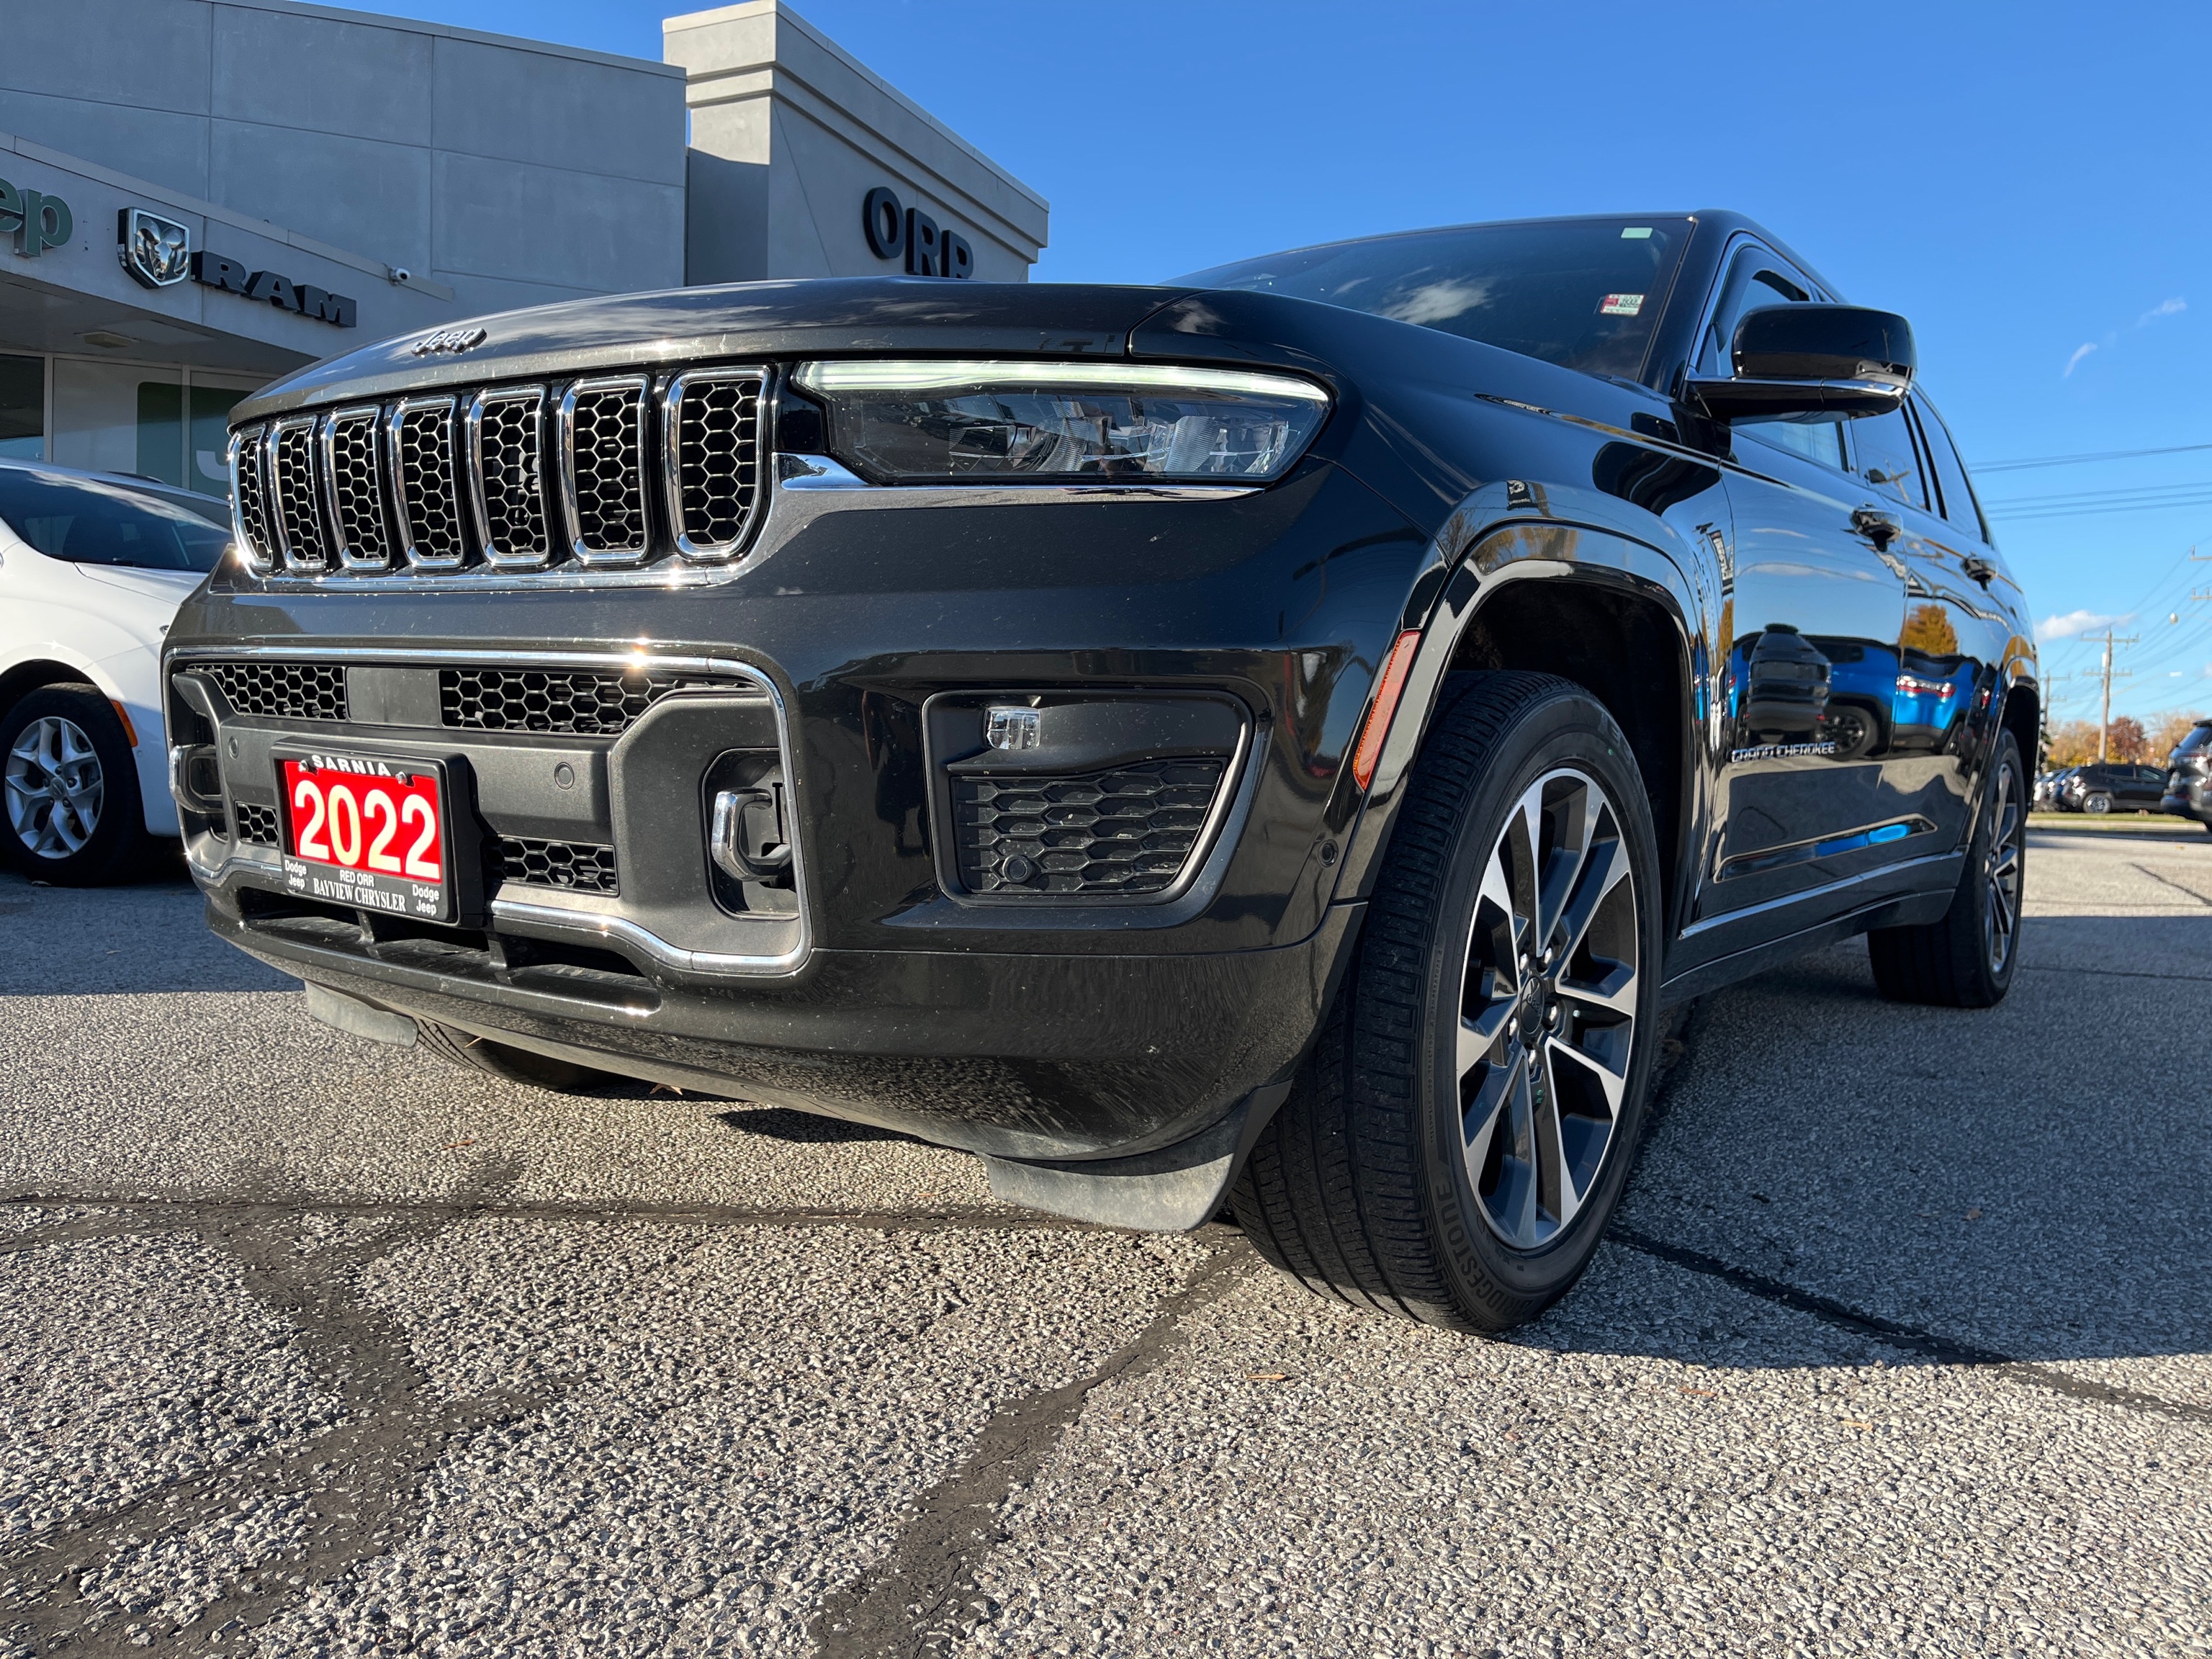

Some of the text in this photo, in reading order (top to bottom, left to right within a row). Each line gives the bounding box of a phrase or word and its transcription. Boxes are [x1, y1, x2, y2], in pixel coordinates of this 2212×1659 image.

[191, 251, 356, 328] RAM
[410, 328, 487, 355] Jeep
[1731, 741, 1835, 763] GRAND CHEROKEE
[311, 755, 391, 777] SARNIA
[295, 780, 441, 879] 2022
[284, 859, 307, 877] Dodge
[339, 869, 374, 887] RED ORR
[288, 873, 305, 890] Jeep
[313, 877, 407, 912] BAYVIEW CHRYSLER
[412, 884, 440, 902] Dodge
[415, 899, 437, 917] Jeep
[1435, 1180, 1535, 1318] BRIDGESTONE
